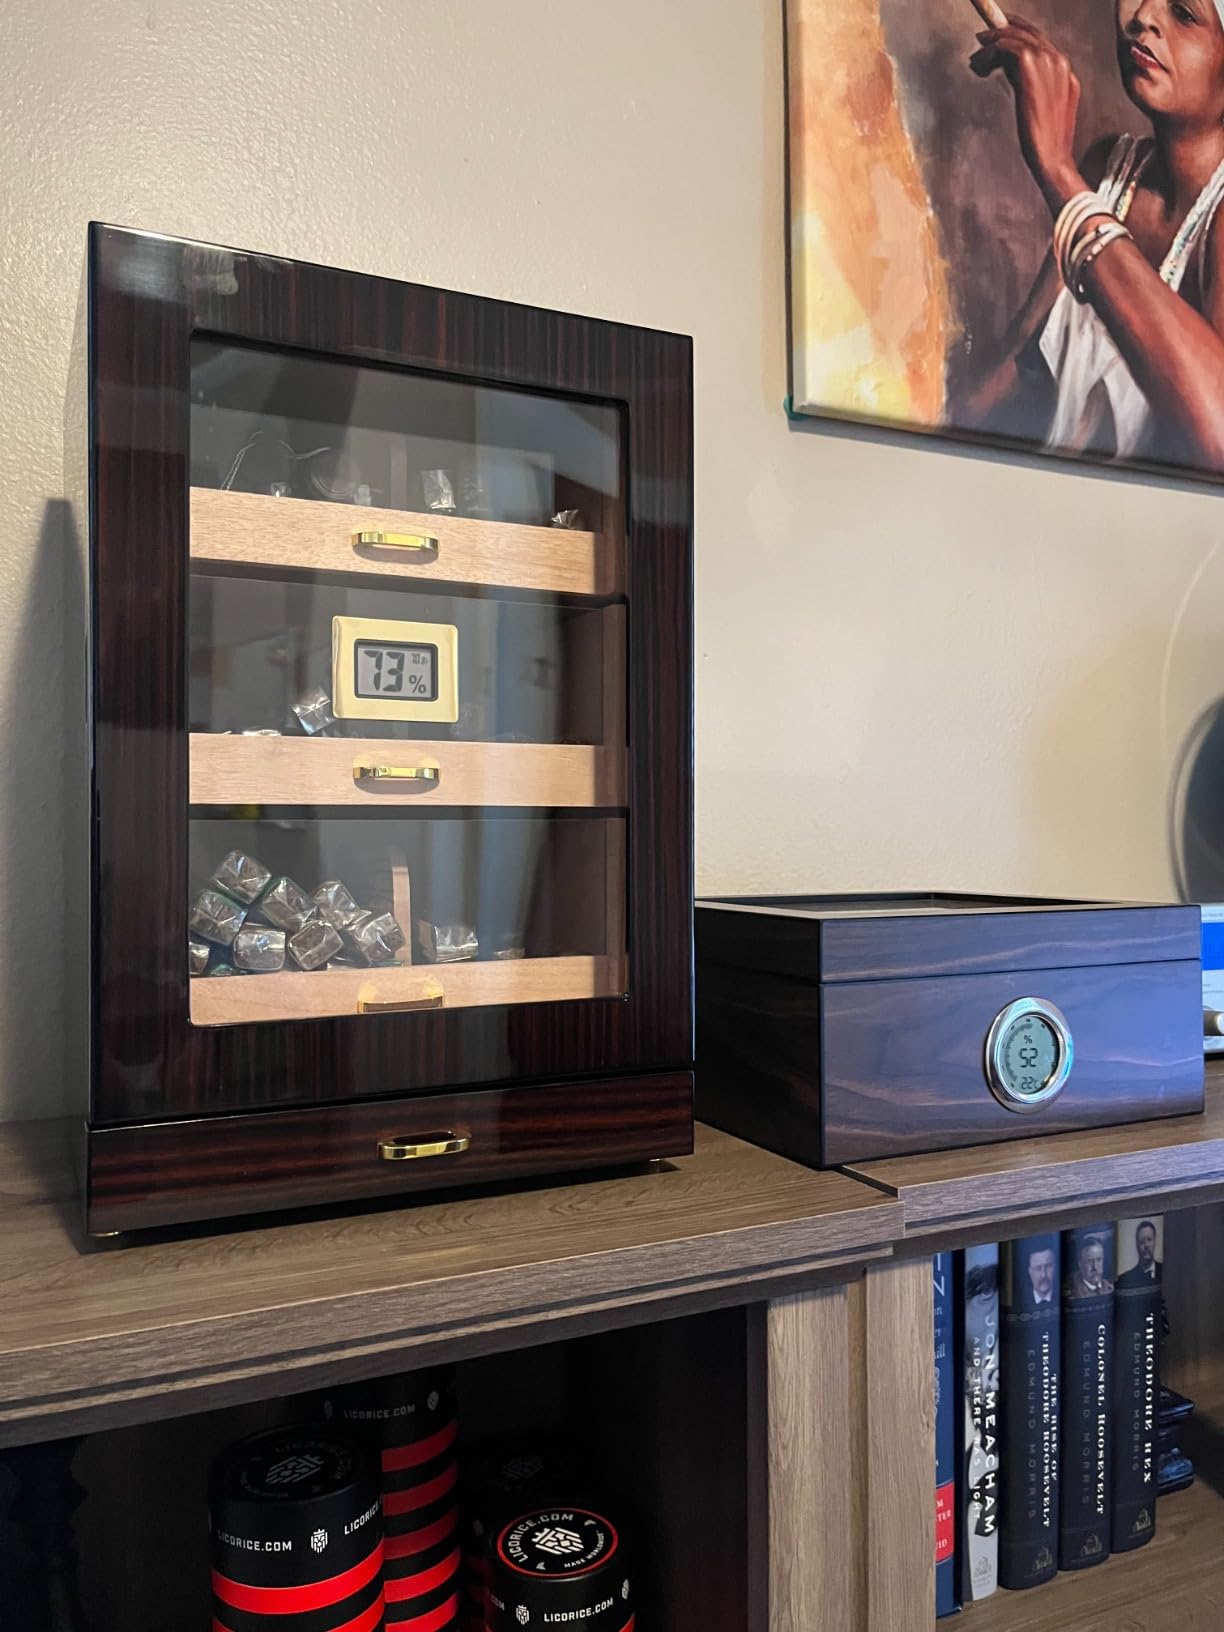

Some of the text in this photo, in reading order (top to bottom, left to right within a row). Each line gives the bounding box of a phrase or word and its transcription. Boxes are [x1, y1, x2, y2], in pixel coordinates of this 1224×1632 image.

[363, 649, 427, 694] 73 %
[973, 1336, 981, 1367] AND
[343, 1403, 415, 1420] LICORICE.COM
[973, 1375, 982, 1425] THERE
[1096, 1324, 1106, 1514] COLONEL ROOSEVELT
[1143, 1312, 1154, 1483] THEODORE REX
[984, 1316, 997, 1533] JON MEACHAM
[1042, 1331, 1051, 1528] THEODORE ROOSEVELT
[1050, 1414, 1058, 1453] RISE
[1050, 1460, 1058, 1481] OF
[972, 1475, 982, 1520] LIGHT
[218, 1530, 293, 1552] LICORICE.COM
[508, 1513, 574, 1563] LICORICE.COM
[543, 1597, 614, 1622] LICORICE.COM
